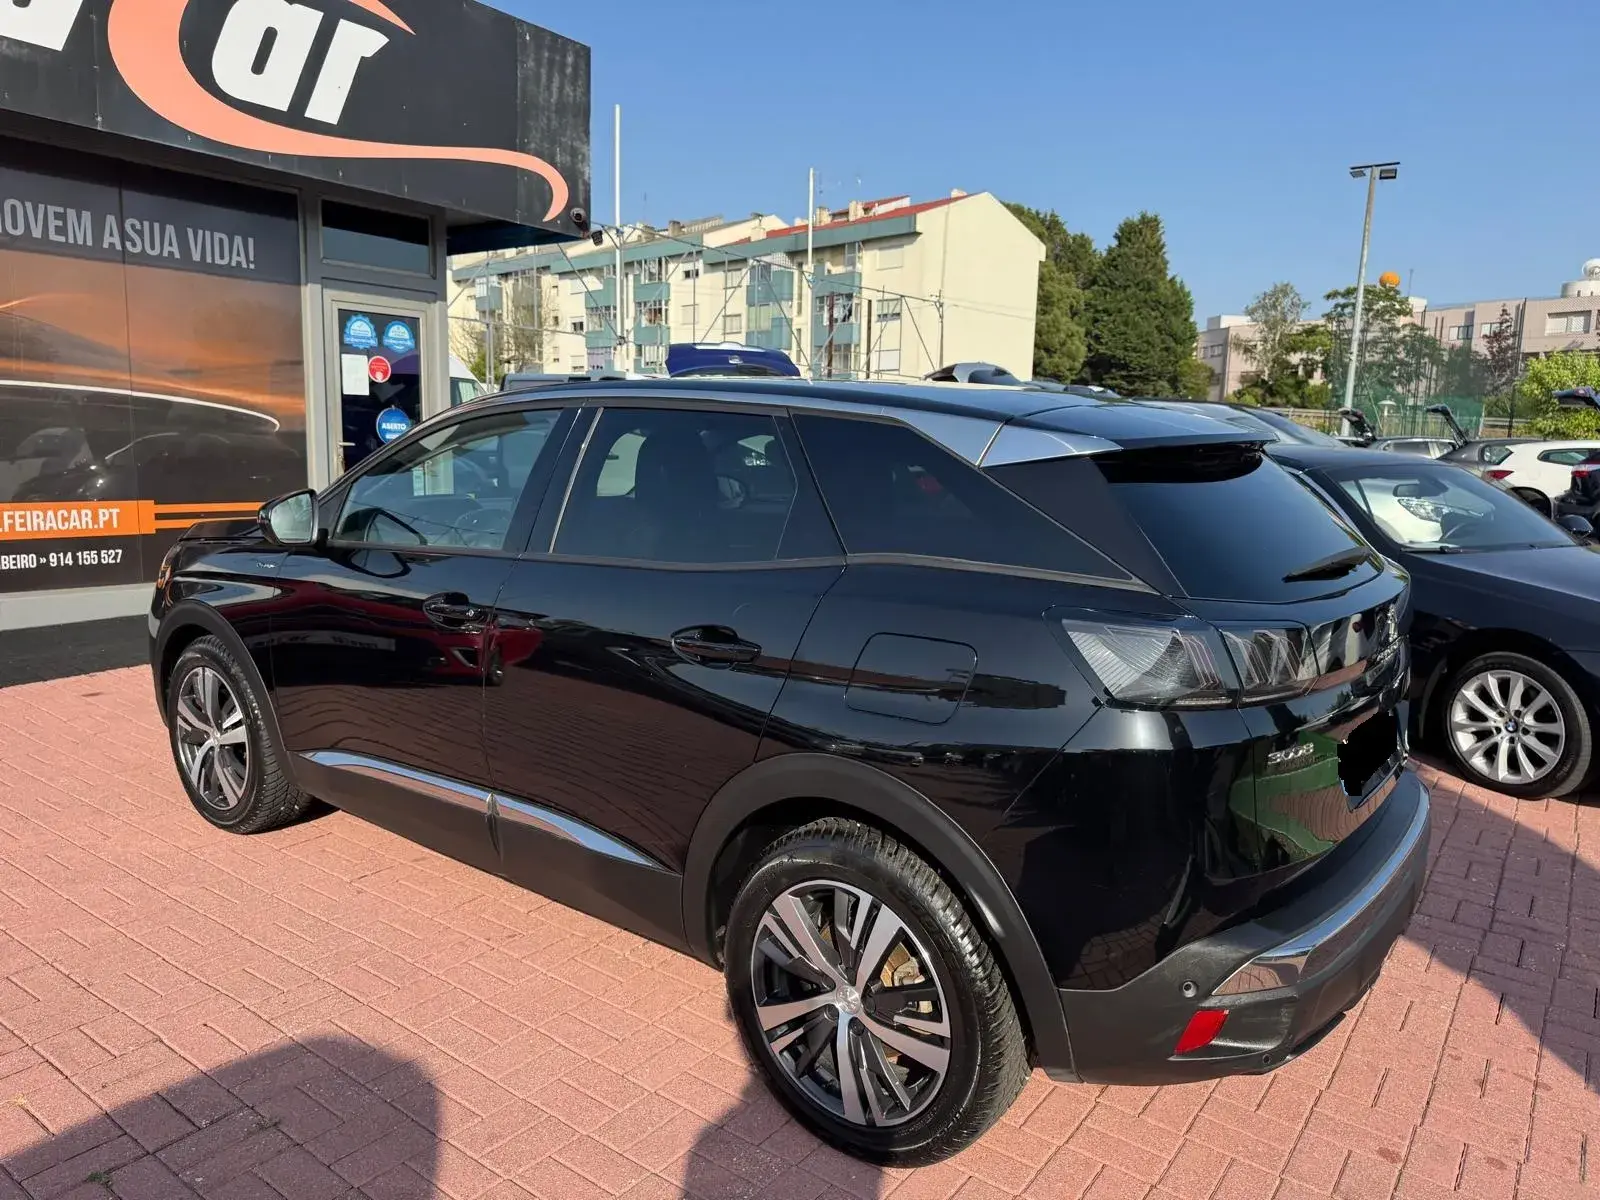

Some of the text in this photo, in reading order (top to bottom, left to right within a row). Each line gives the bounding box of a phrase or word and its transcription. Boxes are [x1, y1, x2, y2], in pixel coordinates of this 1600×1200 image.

[0, 198, 93, 247] OVEM
[186, 227, 256, 270] VIDA!
[0, 553, 37, 570] BEIRO
[49, 552, 73, 567] 914
[76, 550, 98, 565] 155
[100, 549, 123, 564] 527
[1267, 742, 1314, 765] 3008
